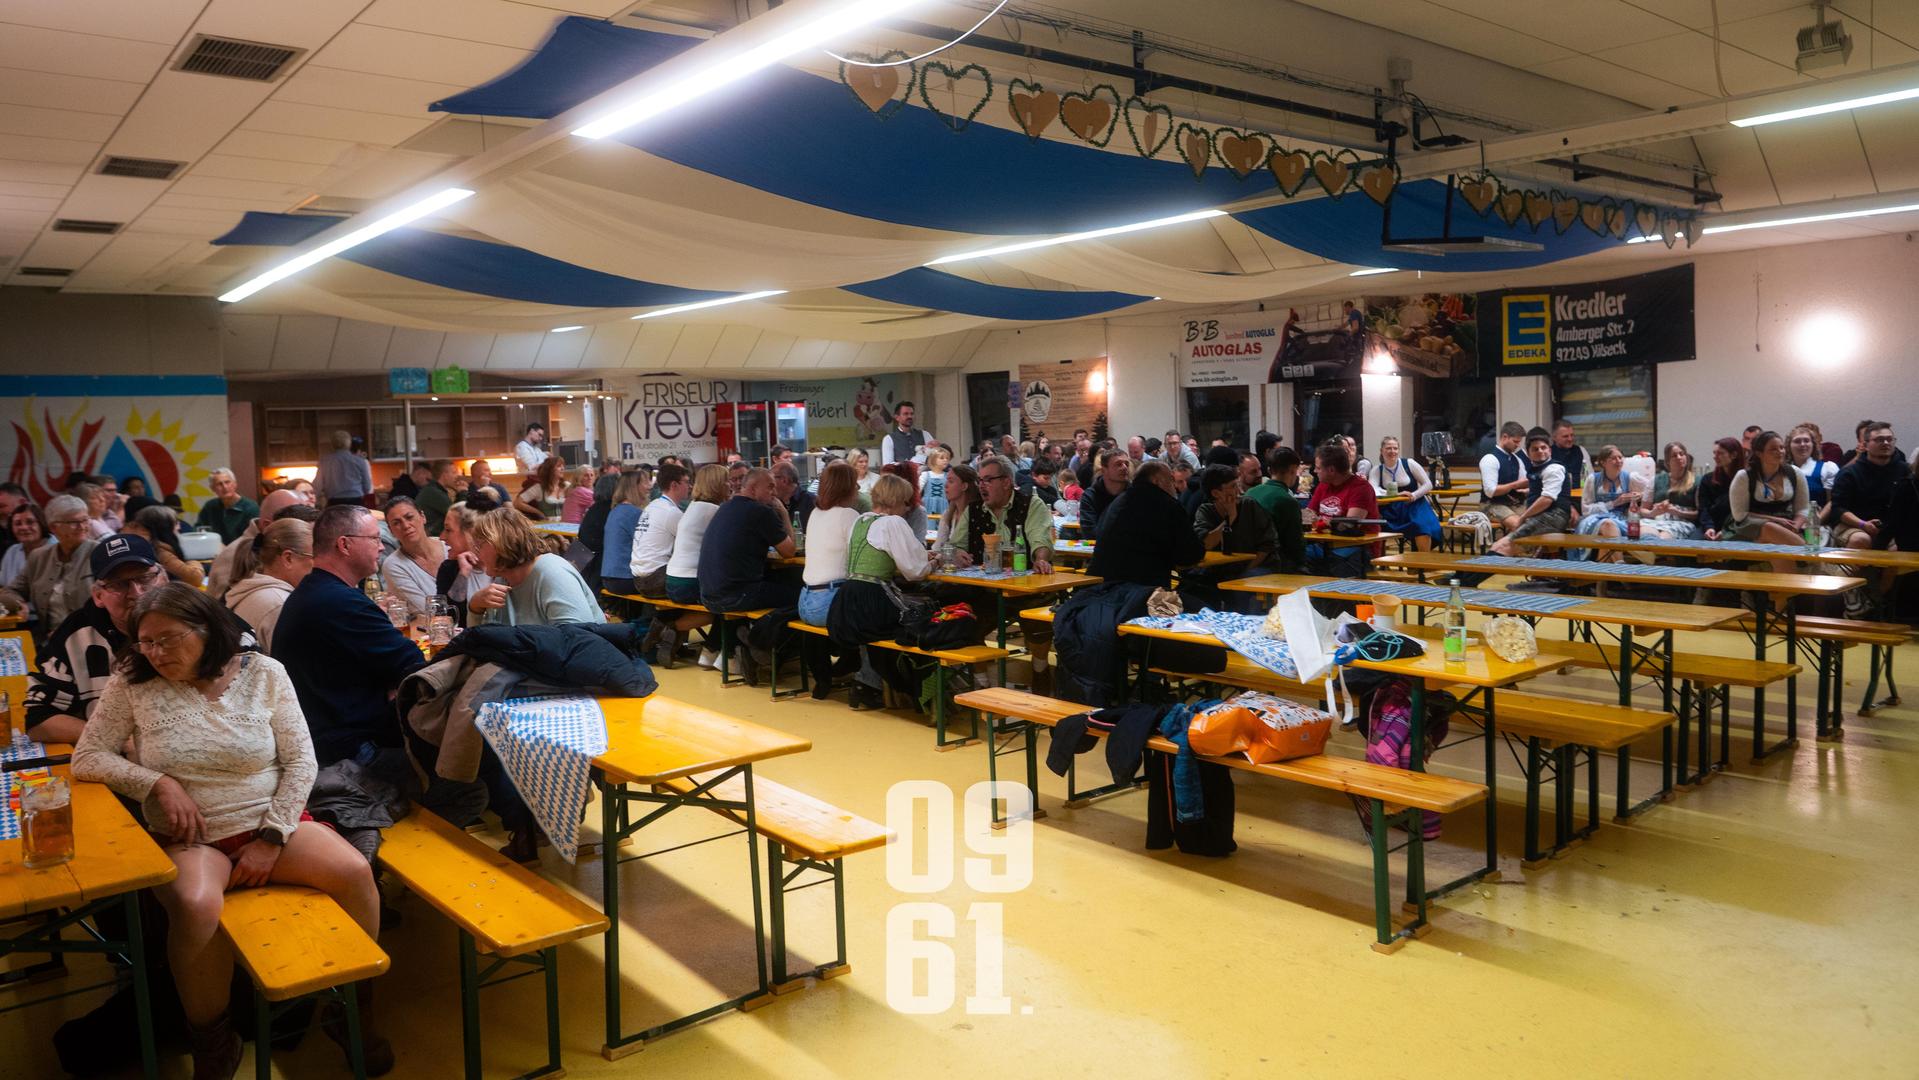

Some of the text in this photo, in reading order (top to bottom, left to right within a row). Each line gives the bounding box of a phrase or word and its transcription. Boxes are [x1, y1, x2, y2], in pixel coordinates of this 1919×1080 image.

[1555, 291, 1626, 321] Kredler
[1245, 328, 1275, 338] AUTOGLAS
[1556, 326, 1605, 343] Amberger
[1606, 322, 1626, 337] Str.
[1192, 342, 1263, 358] AUTOGLAS
[1508, 349, 1546, 358] EDEKA
[1556, 345, 1591, 362] 92249
[643, 381, 729, 405] FRISEUR
[808, 401, 848, 419] überl
